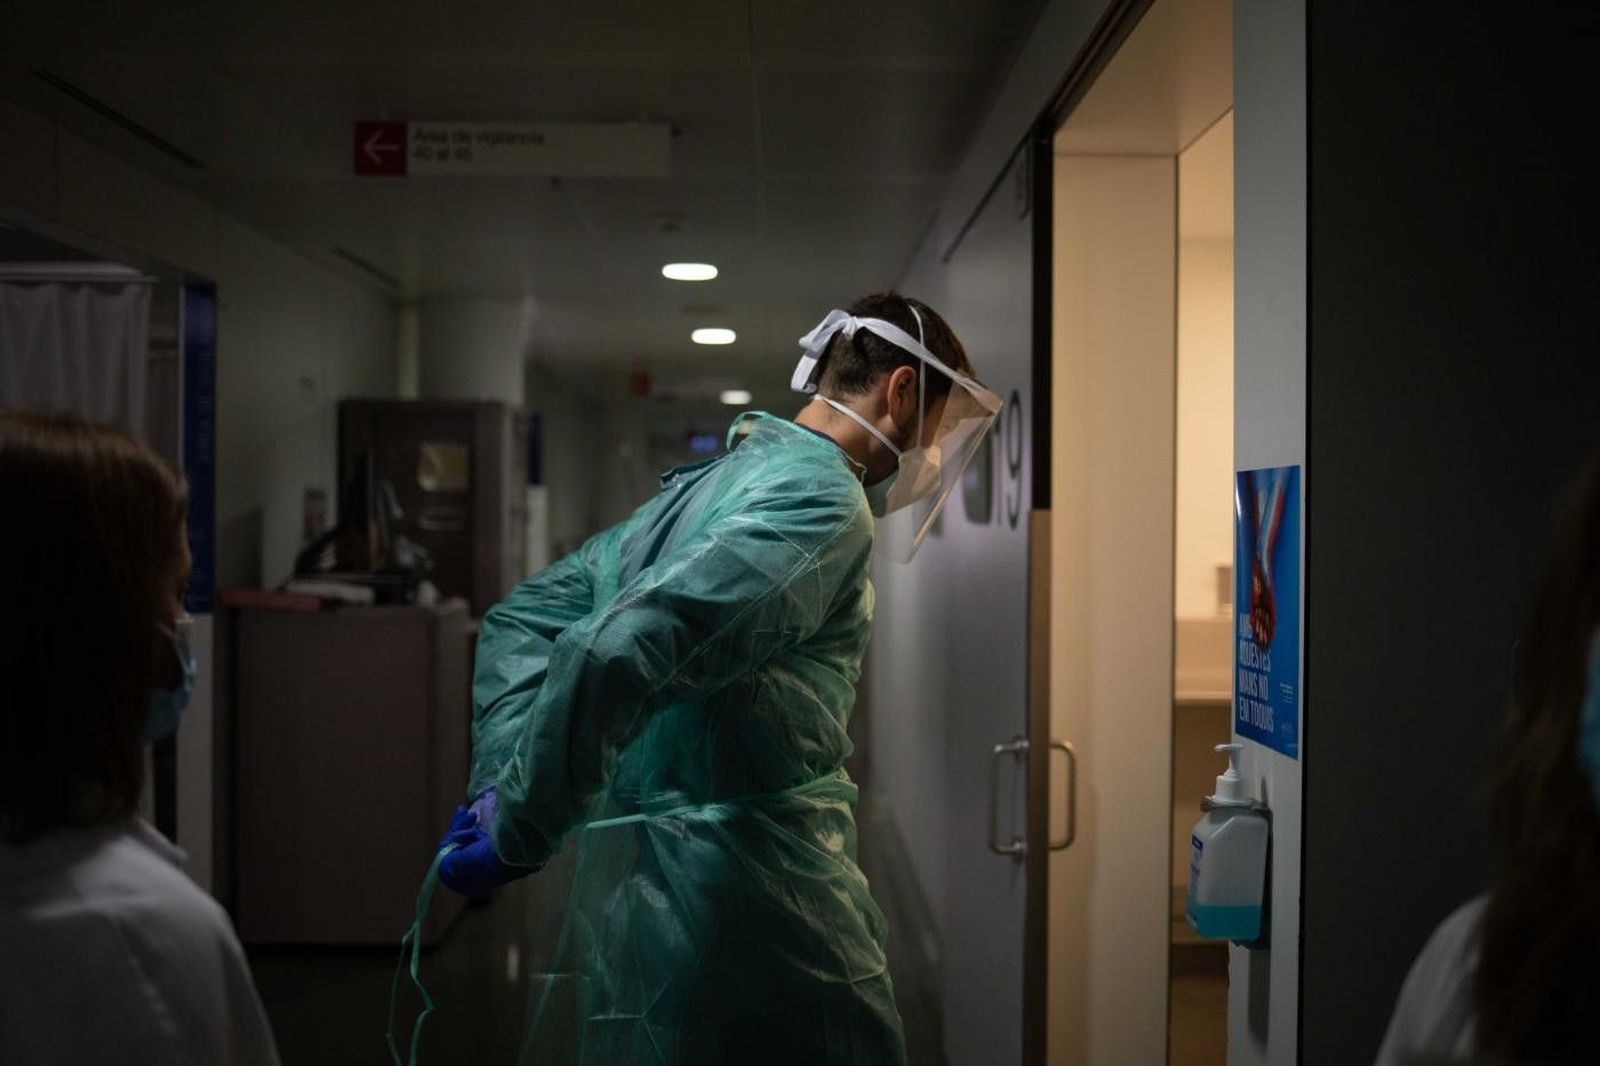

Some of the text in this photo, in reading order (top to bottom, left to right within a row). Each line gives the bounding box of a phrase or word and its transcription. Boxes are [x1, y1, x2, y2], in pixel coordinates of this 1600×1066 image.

[452, 130, 471, 144] de
[1258, 671, 1269, 701] NO
[1239, 696, 1250, 723] EM
